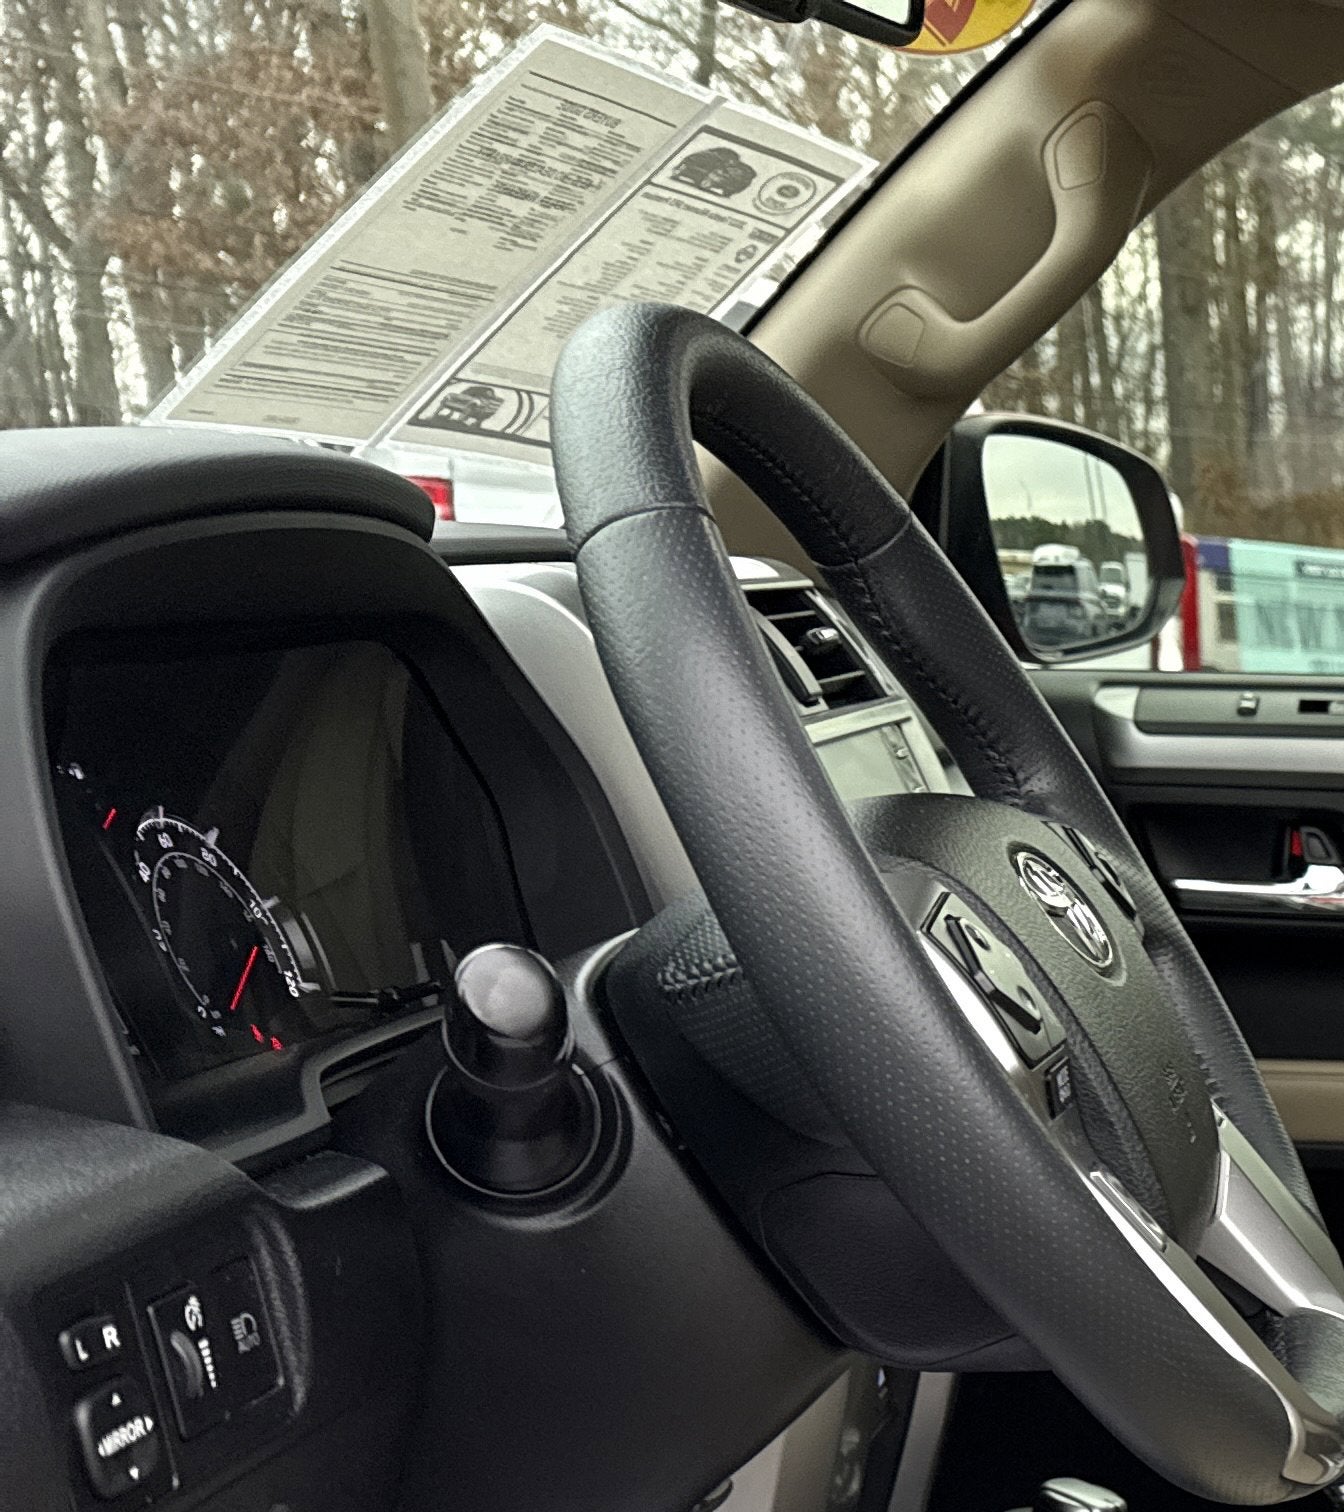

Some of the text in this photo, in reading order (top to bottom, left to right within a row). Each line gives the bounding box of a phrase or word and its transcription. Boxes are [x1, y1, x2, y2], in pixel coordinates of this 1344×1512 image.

[284, 970, 299, 998] 120
[75, 1325, 120, 1360] L R
[102, 1416, 147, 1456] MIRROR
